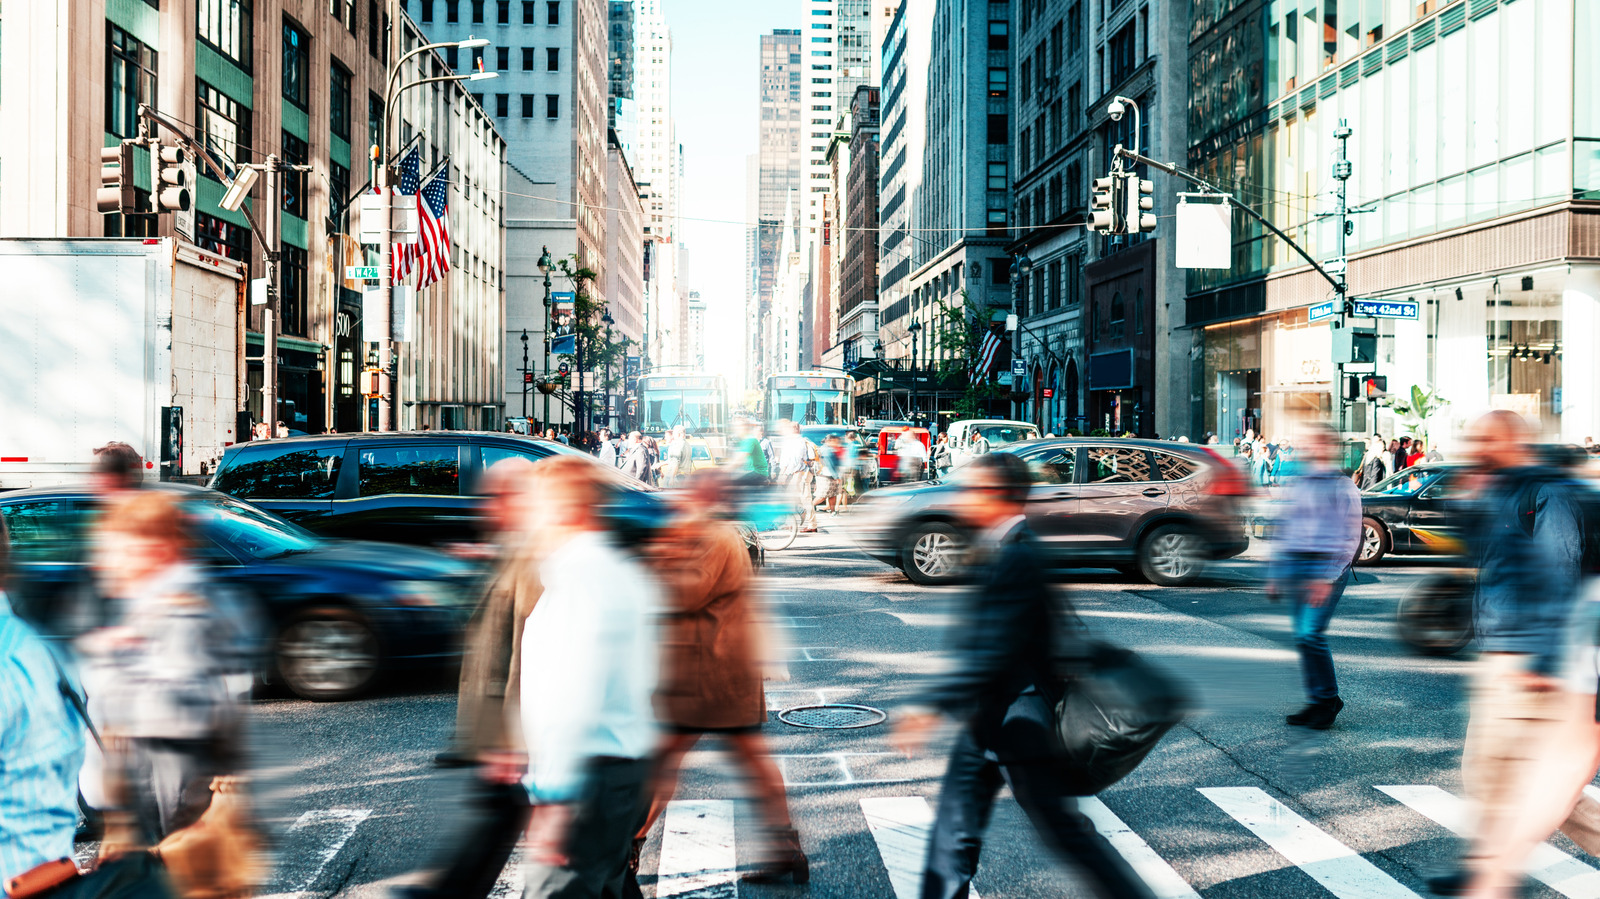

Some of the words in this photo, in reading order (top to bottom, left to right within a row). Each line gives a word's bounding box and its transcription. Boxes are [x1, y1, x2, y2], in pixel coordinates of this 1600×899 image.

[356, 268, 362, 277] W
[362, 268, 373, 277] 42
[1356, 303, 1378, 314] East
[1379, 304, 1402, 315] 42nd
[1403, 306, 1415, 316] St
[337, 312, 350, 338] 500
